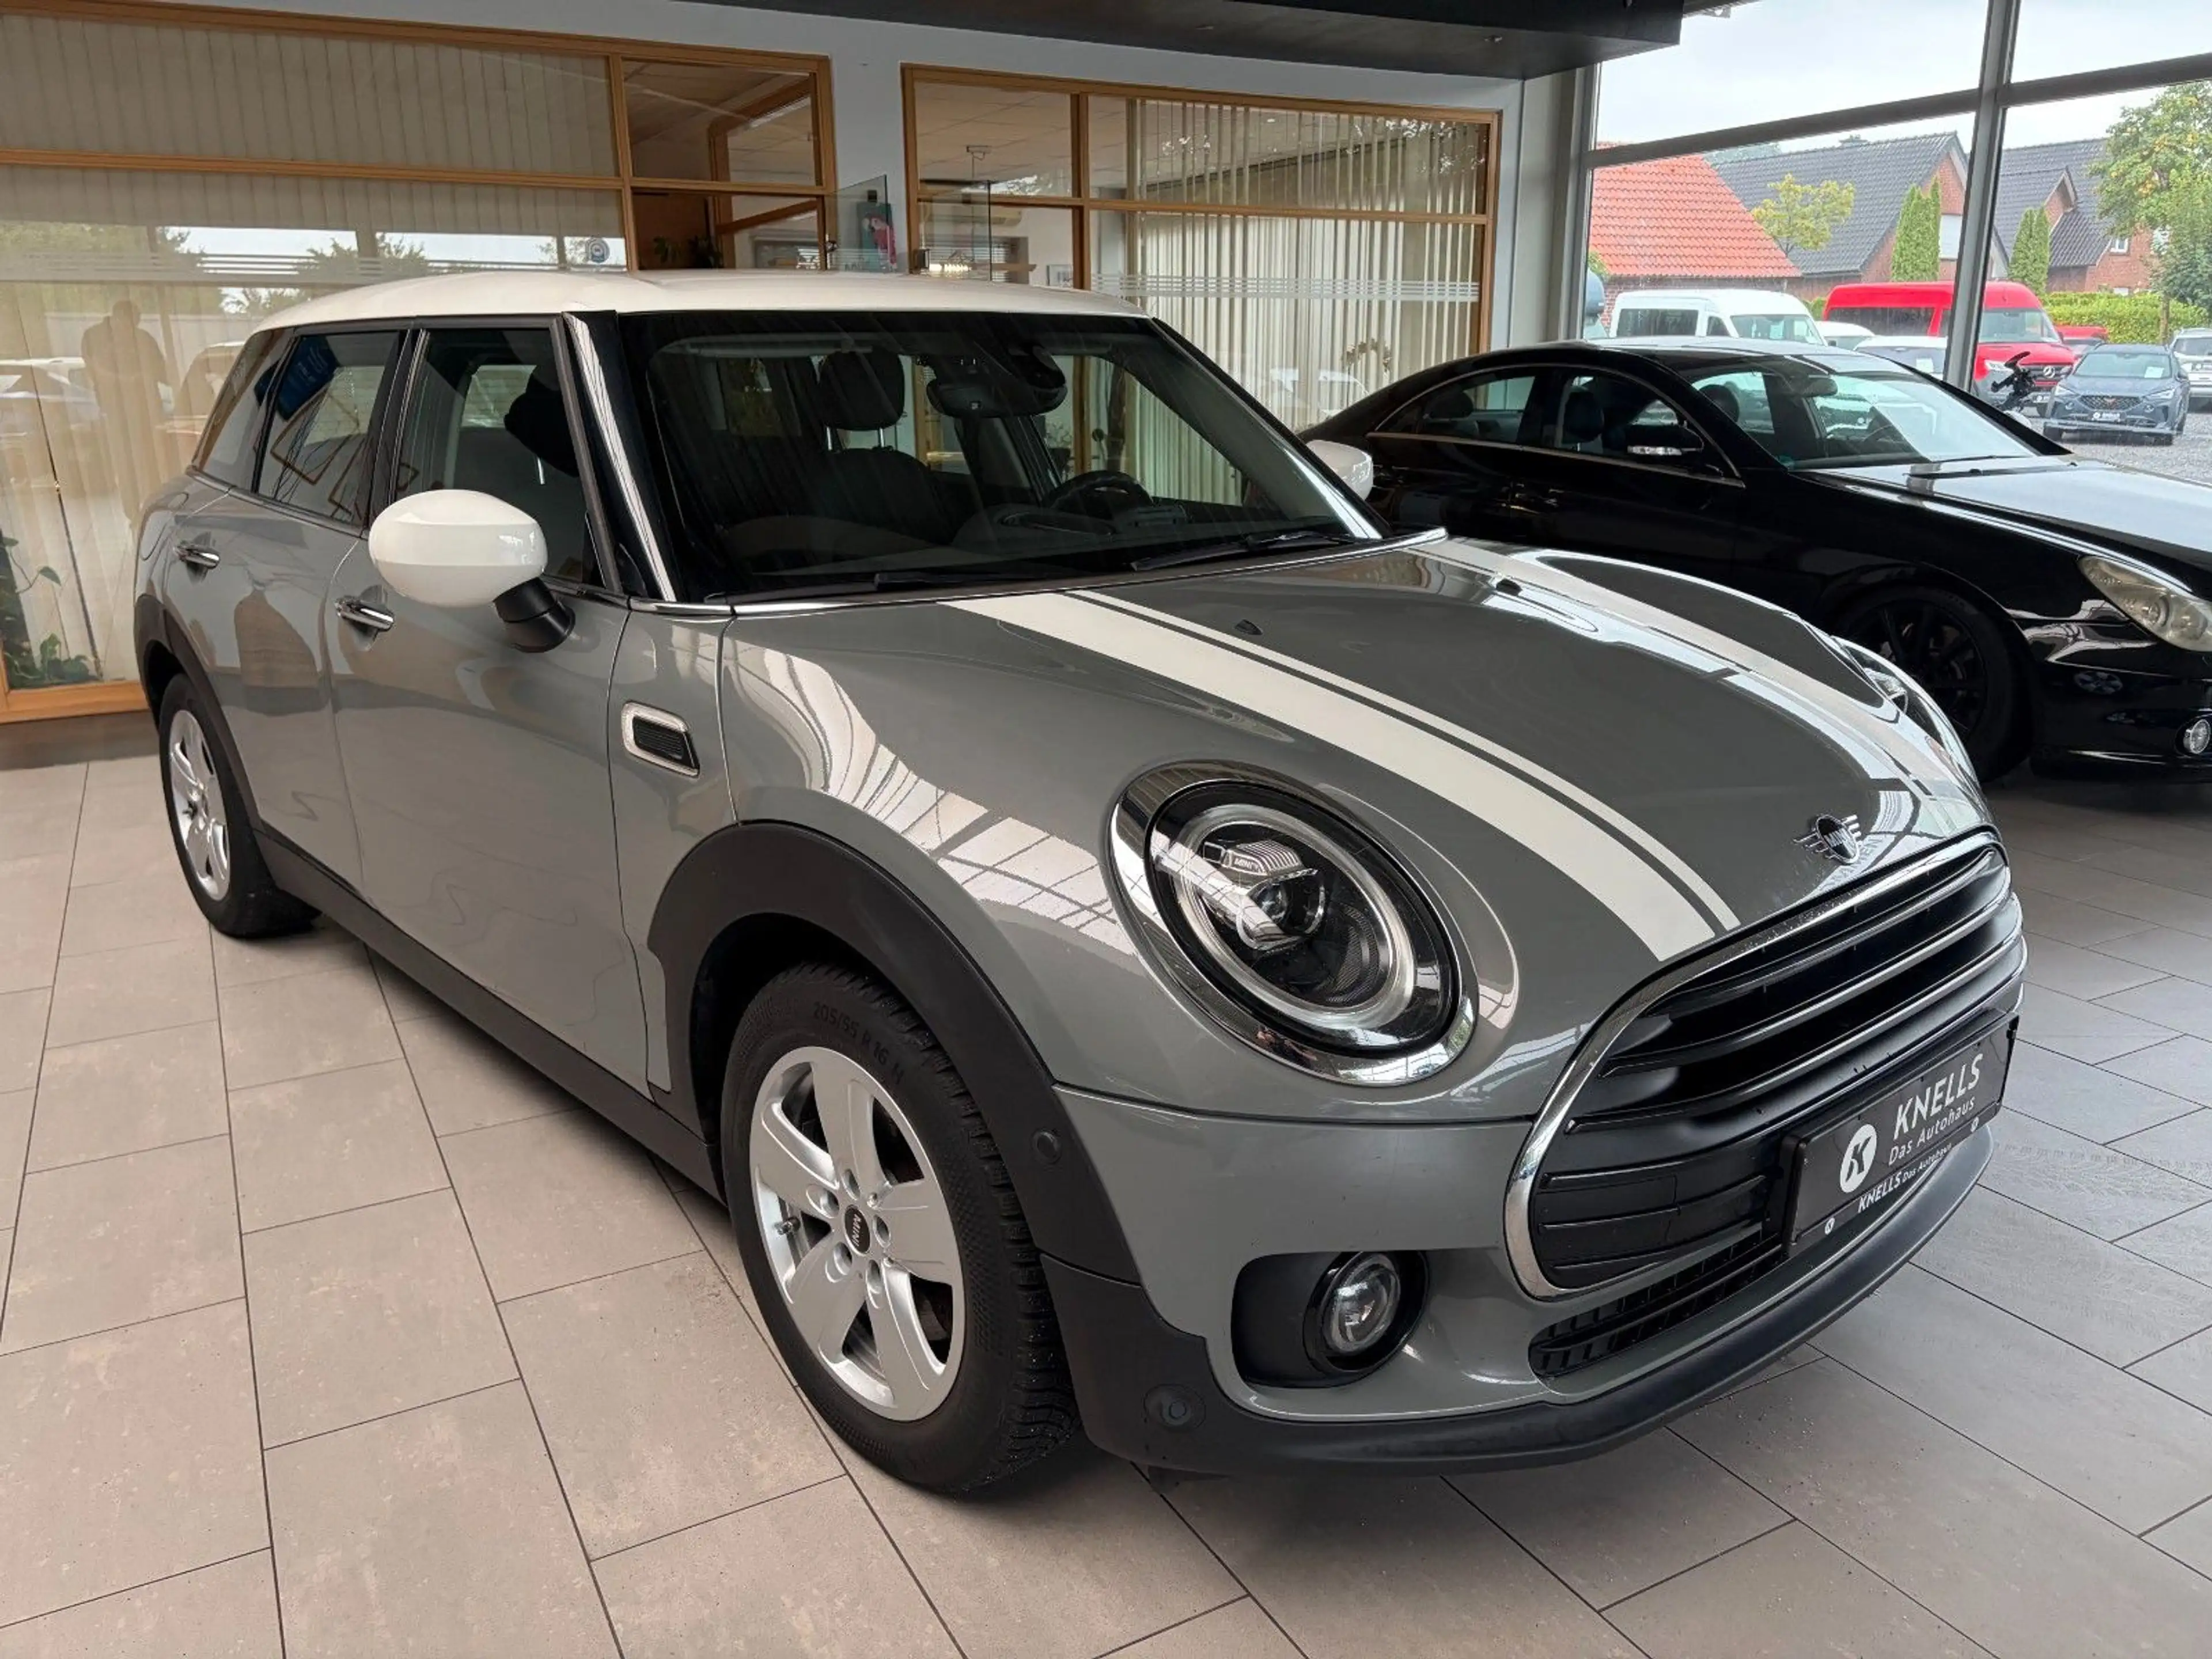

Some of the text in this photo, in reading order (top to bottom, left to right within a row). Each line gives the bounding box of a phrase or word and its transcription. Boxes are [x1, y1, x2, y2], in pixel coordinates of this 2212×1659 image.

[1889, 1097, 1975, 1166] Das Autohaus
[1894, 1054, 1983, 1140] KNELLS
[1858, 1171, 1902, 1213] KNELLS
